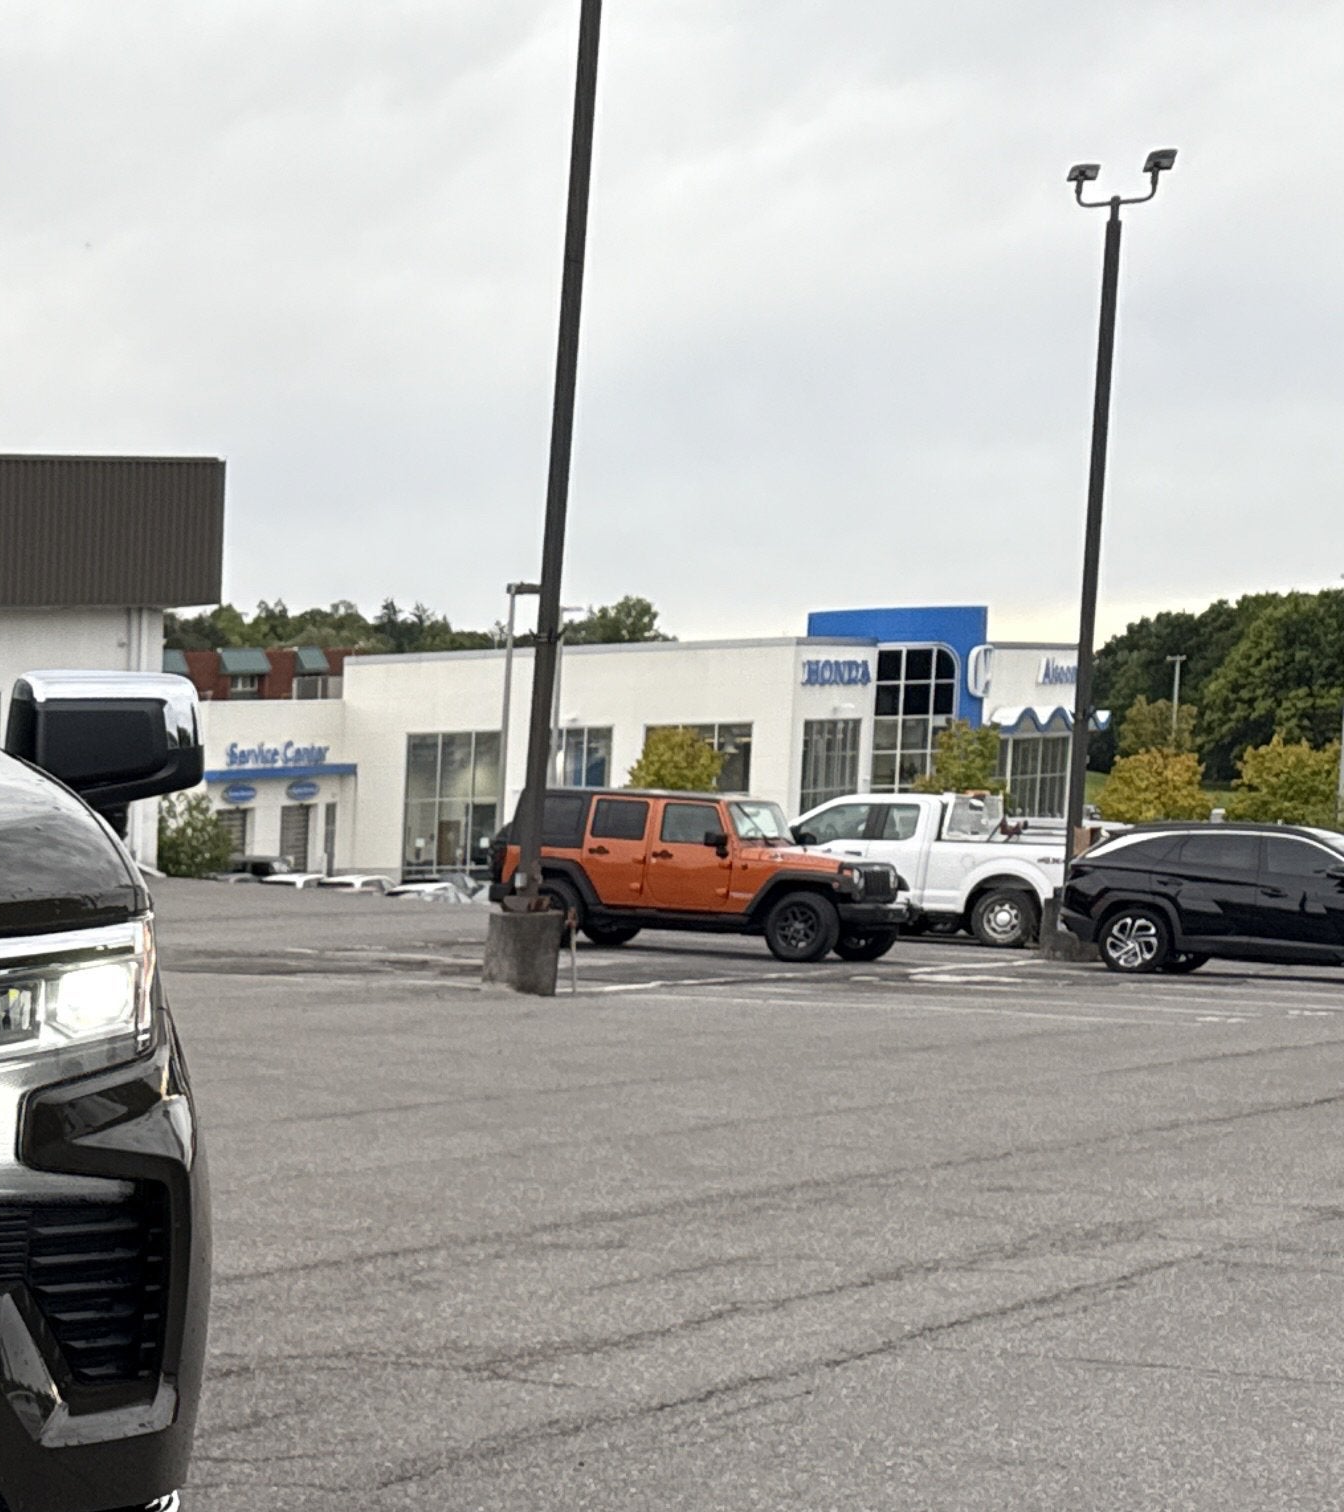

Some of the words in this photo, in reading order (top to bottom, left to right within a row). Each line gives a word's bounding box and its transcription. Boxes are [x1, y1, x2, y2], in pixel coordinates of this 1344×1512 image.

[802, 659, 871, 686] HONDA
[226, 742, 280, 766] Service
[284, 741, 330, 765] Center
